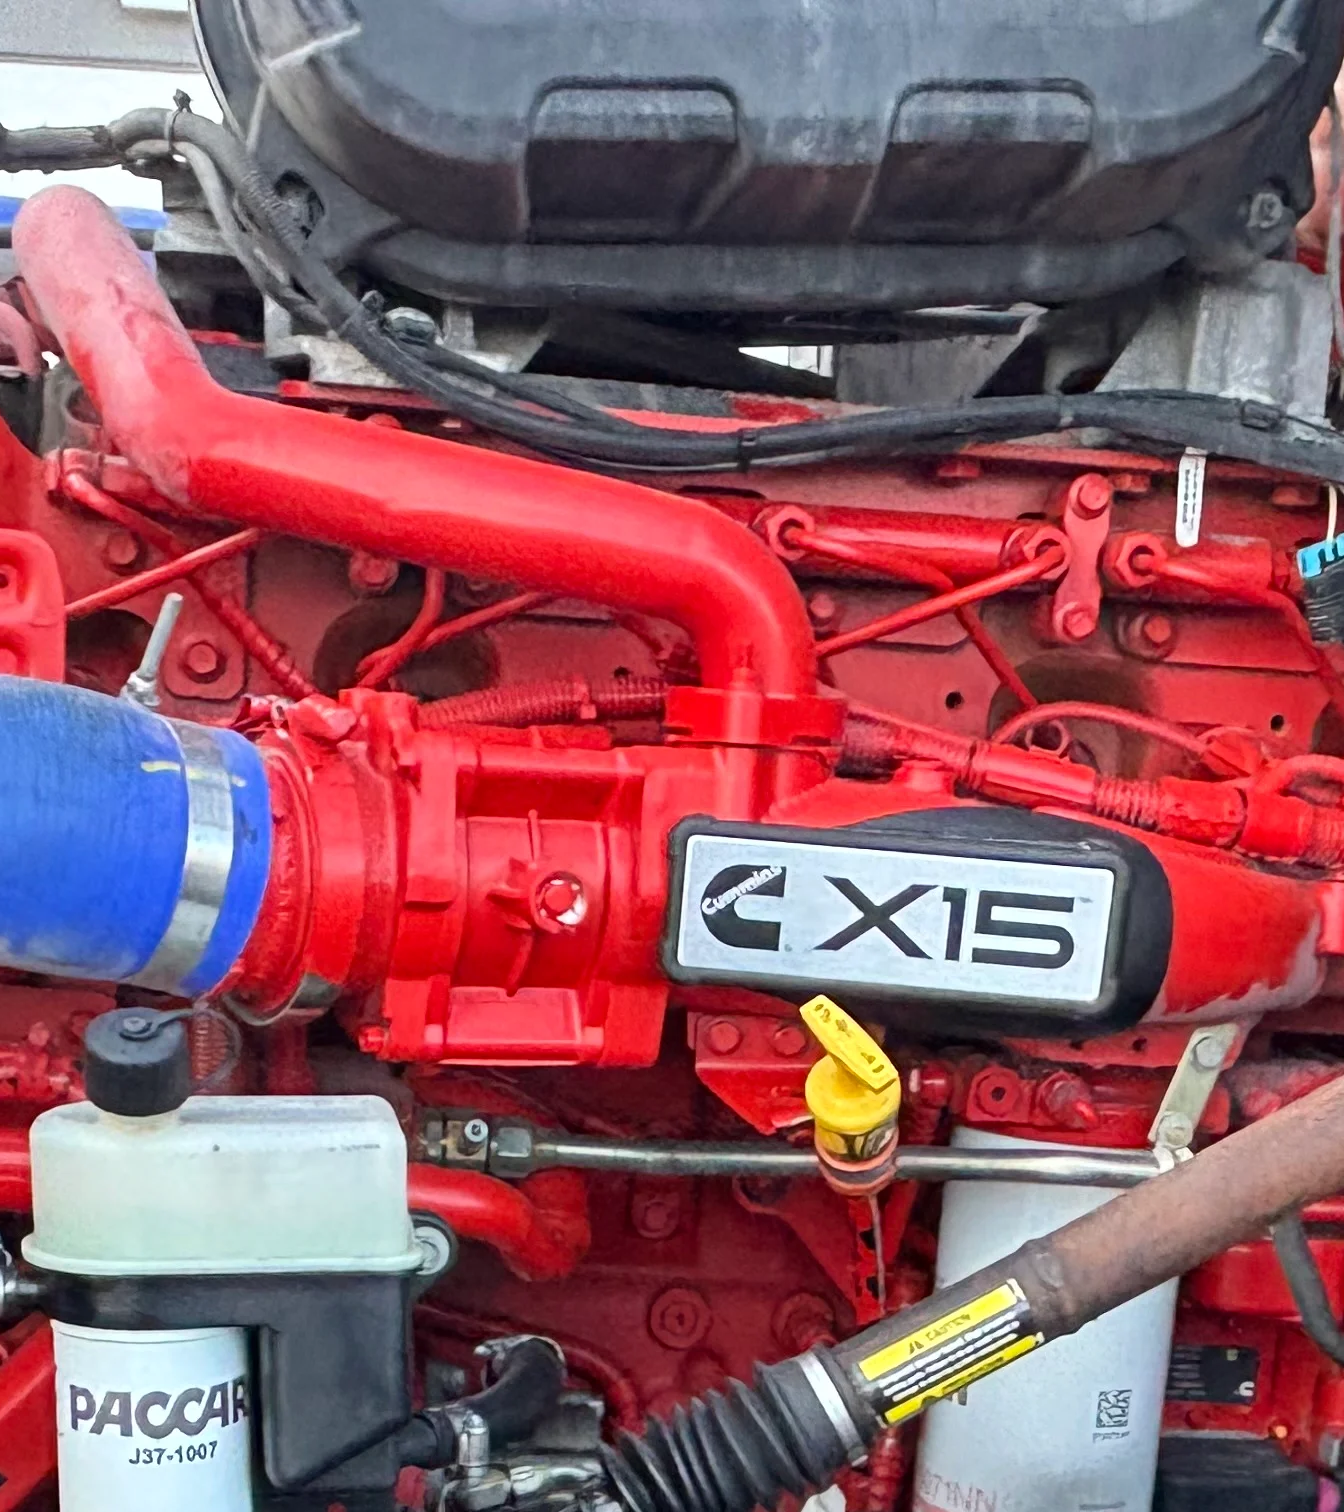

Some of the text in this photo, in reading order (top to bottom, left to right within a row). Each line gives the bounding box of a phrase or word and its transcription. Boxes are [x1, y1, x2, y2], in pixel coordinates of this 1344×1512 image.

[701, 865, 782, 915] Cummins
[811, 874, 1076, 970] X15
[69, 1376, 250, 1440] PACCAR
[128, 1441, 219, 1466] J37-1007
